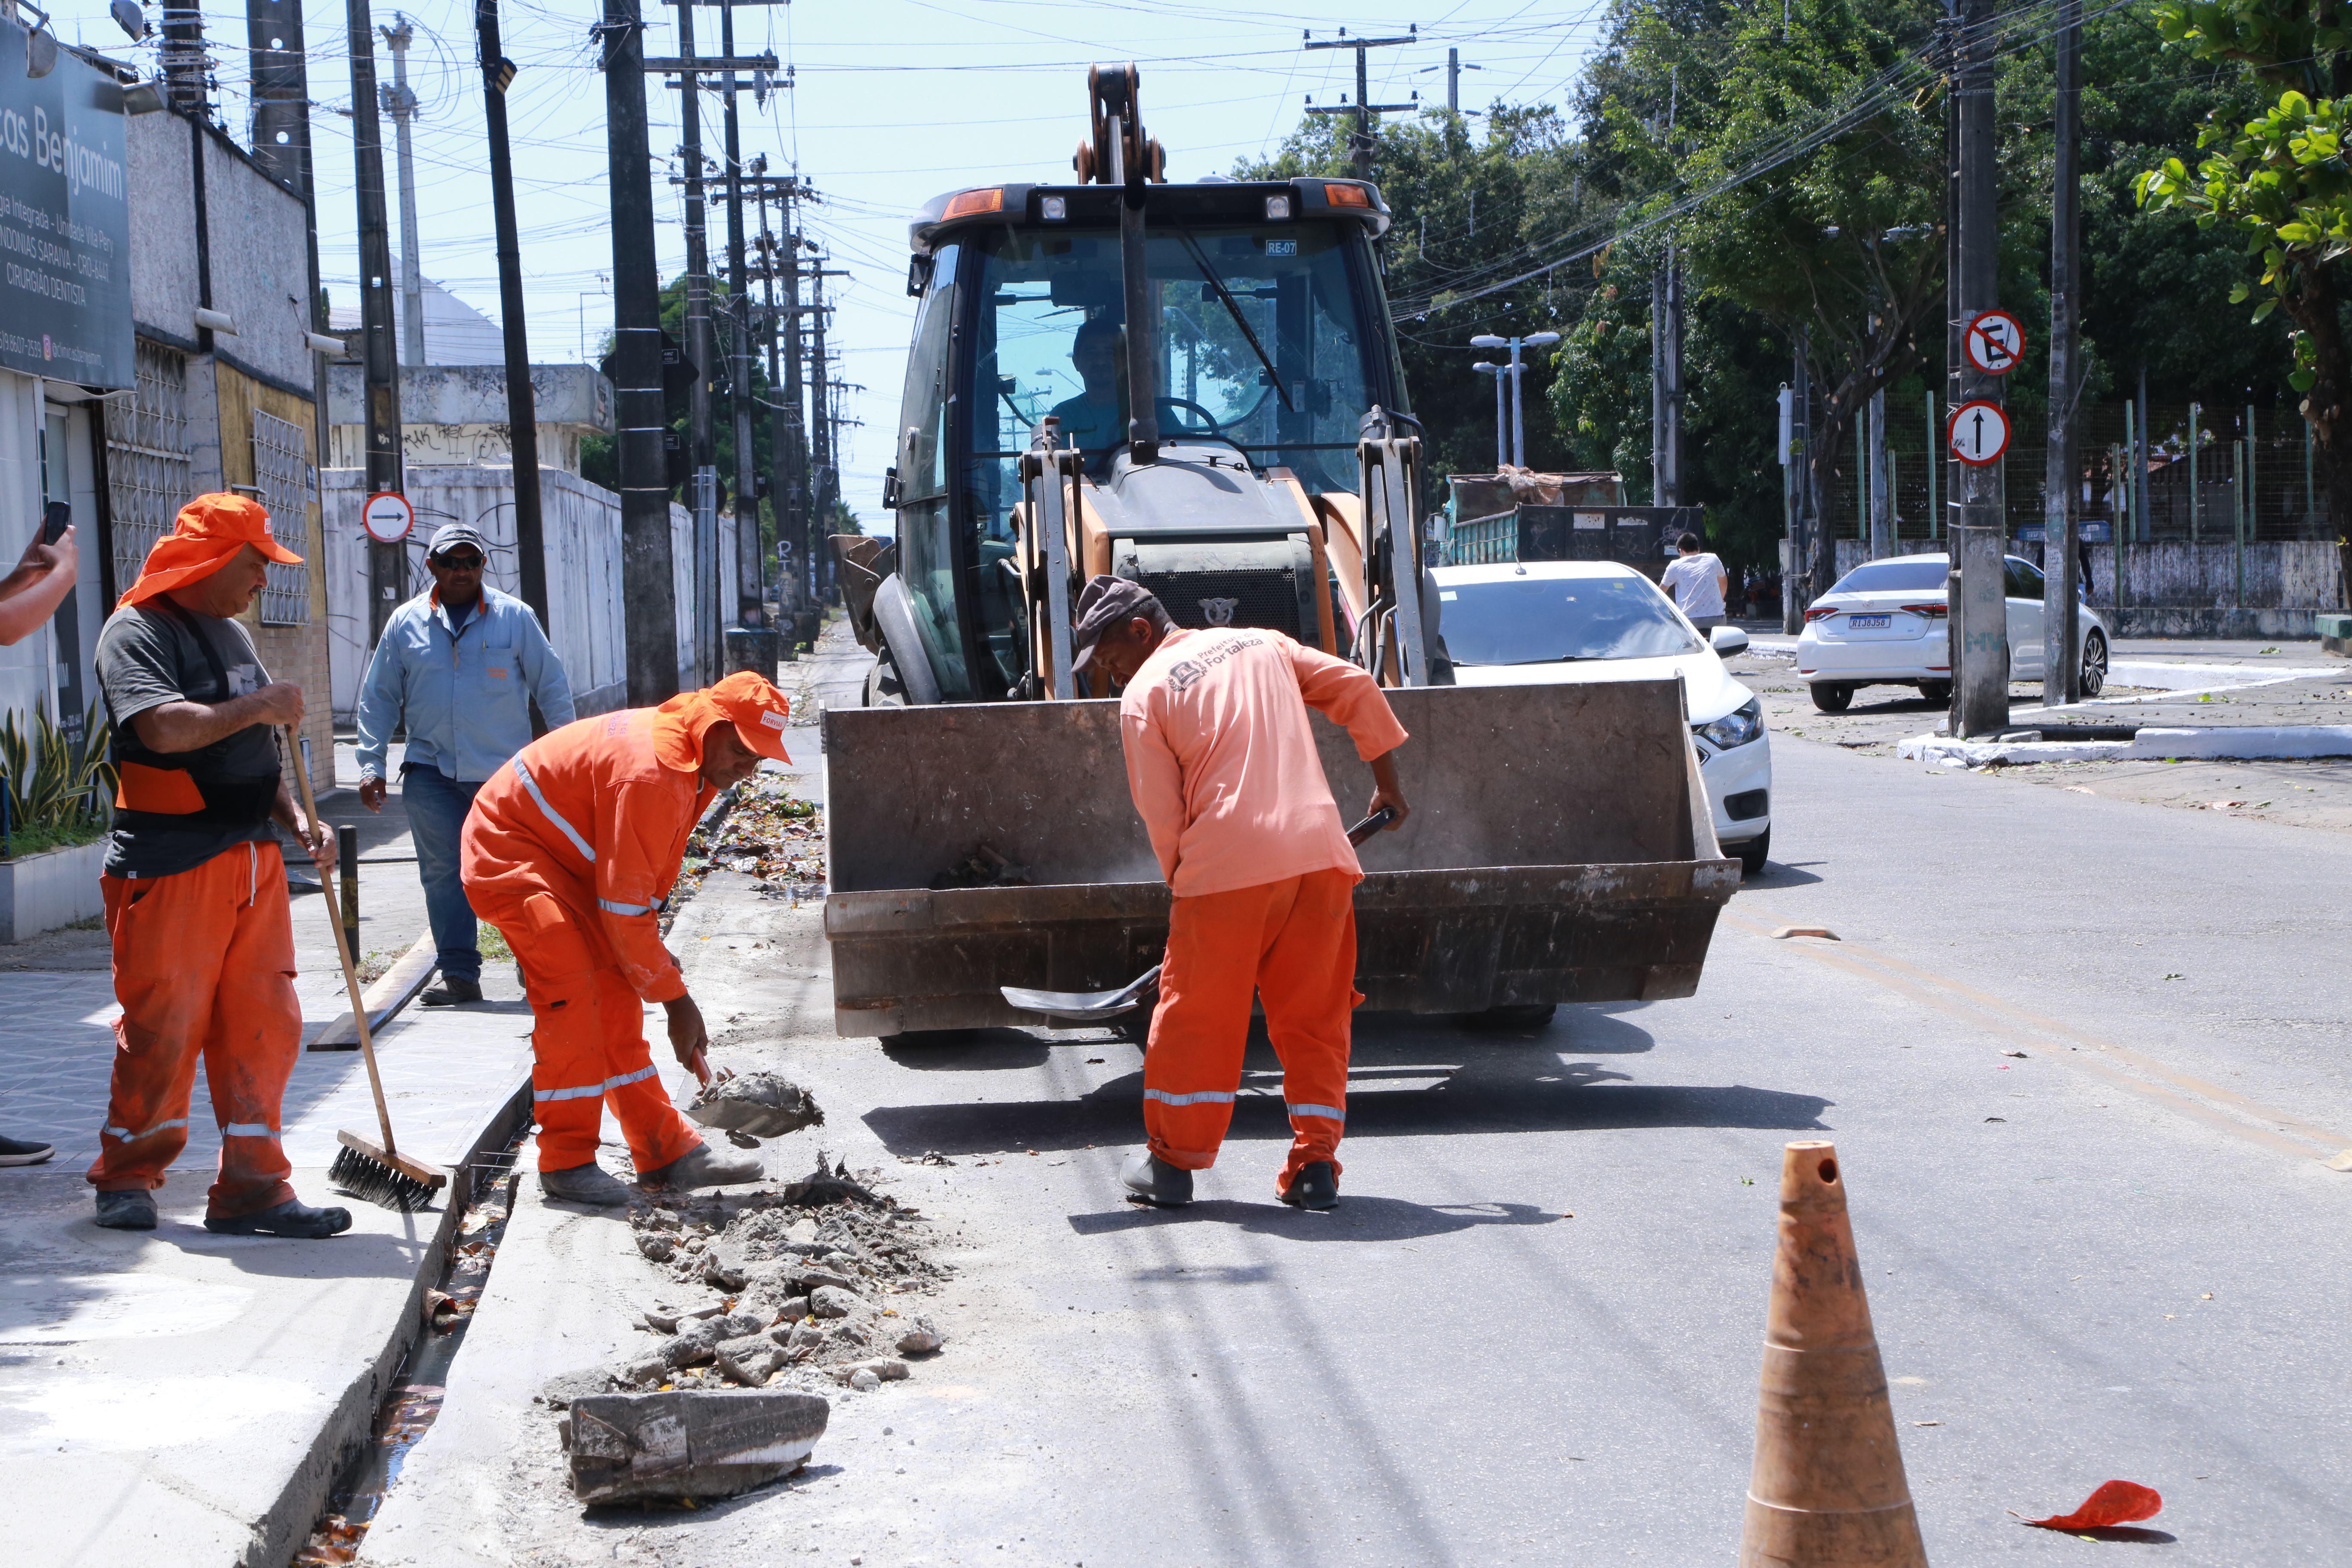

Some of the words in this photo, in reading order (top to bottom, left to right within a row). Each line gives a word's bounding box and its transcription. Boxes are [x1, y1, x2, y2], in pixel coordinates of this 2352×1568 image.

[0, 109, 29, 159] as
[34, 105, 122, 200] Benjamim
[12, 195, 49, 229] Integrada
[56, 214, 84, 243] Unidade
[85, 225, 98, 248] Vila
[99, 230, 113, 258] Pery
[0, 225, 36, 258] NDONIAS
[38, 239, 71, 270] SARAIVA
[78, 254, 108, 282] CRO-6441
[1268, 242, 1295, 253] RE-07
[7, 262, 49, 296] CIRURGIÃO
[51, 277, 86, 306] DENTISTA
[1982, 324, 2008, 362] E
[1852, 619, 1885, 627] RIJ8J58
[1197, 635, 1242, 658] Prefeitura
[1204, 638, 1264, 667] Fortaleza
[763, 716, 783, 727] FORVIAS
